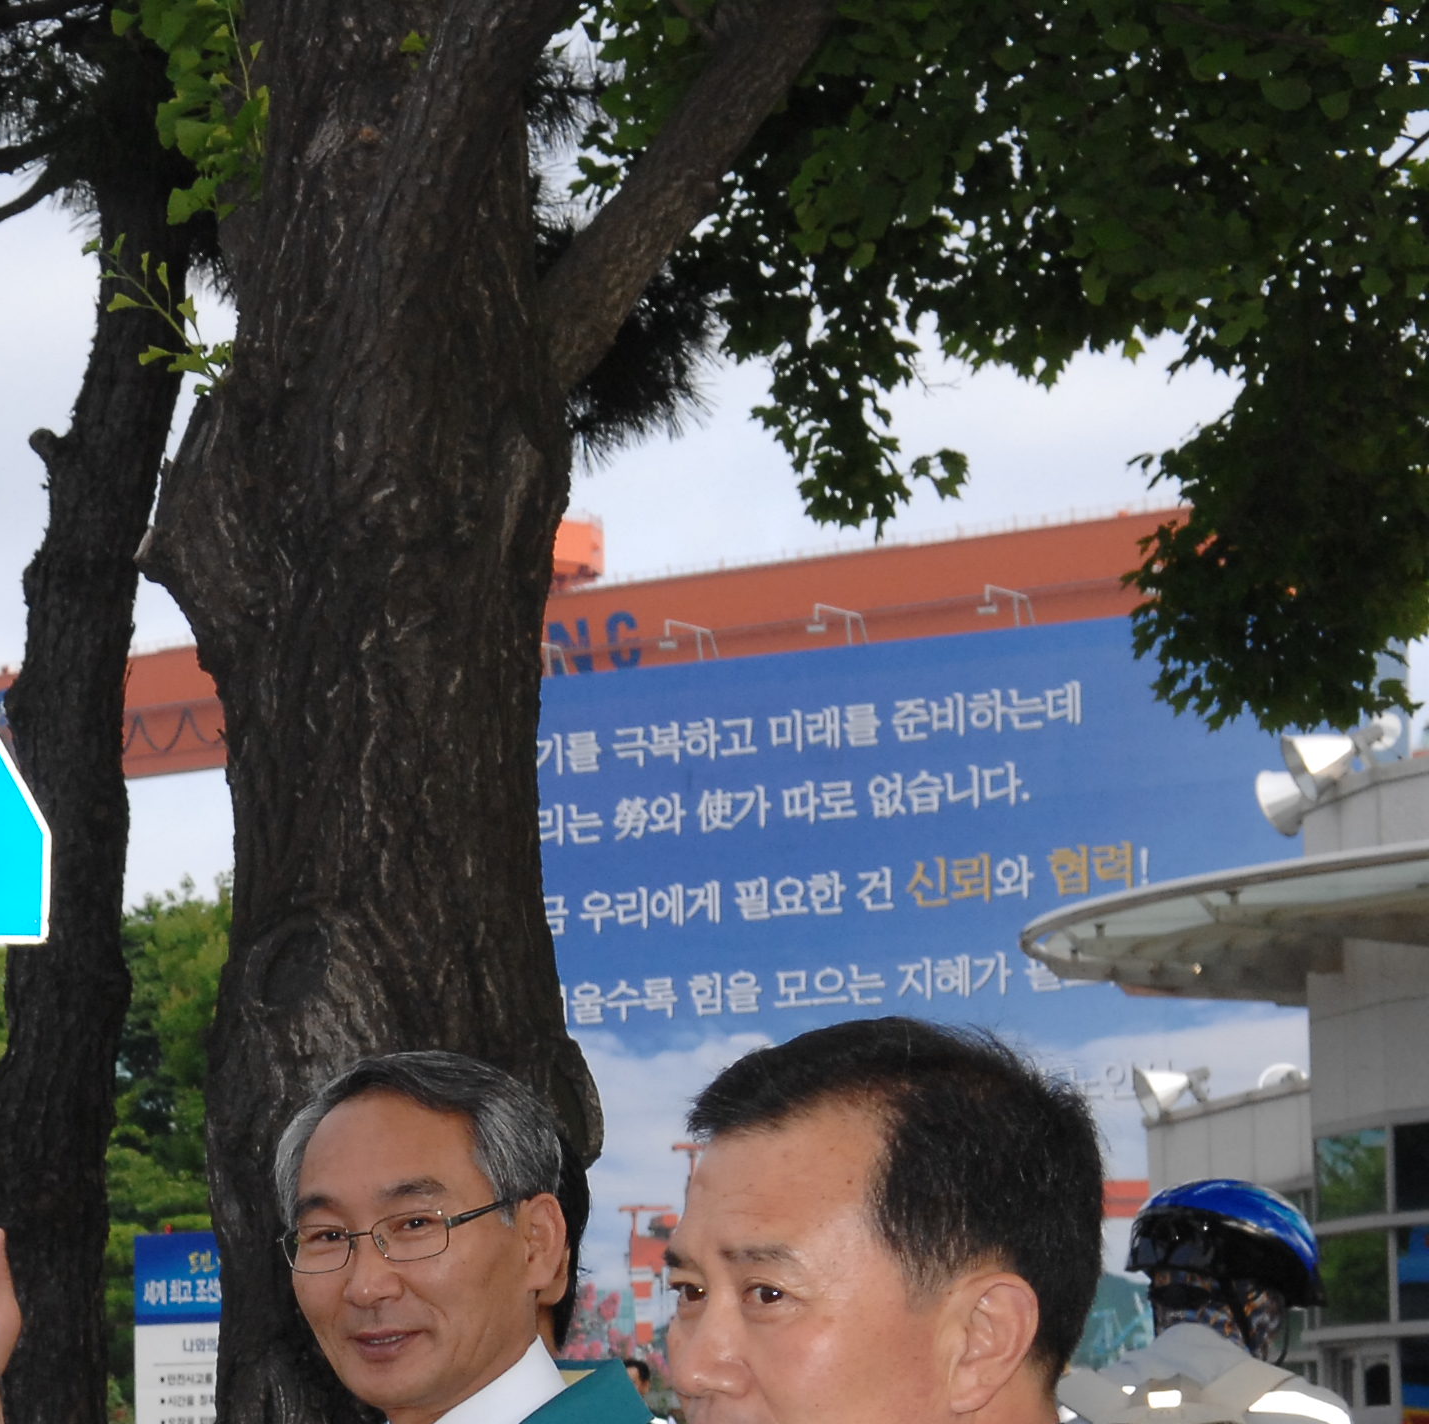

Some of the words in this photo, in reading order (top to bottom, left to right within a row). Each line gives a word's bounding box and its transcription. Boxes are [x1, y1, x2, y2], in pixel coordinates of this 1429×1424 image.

[612, 717, 758, 768] 극복하고
[768, 701, 881, 752] 미래를
[892, 679, 1082, 743] 준비하는데
[782, 780, 857, 825] 따로
[868, 760, 1031, 819] 없습니다.
[579, 879, 722, 935] 우리에게
[734, 870, 847, 921] 필요한
[857, 865, 895, 912] 건
[905, 852, 1034, 908] 신뢰와
[687, 968, 762, 1017] 힘을
[773, 962, 886, 1009] 모으는
[897, 951, 1013, 1001] 지혜가
